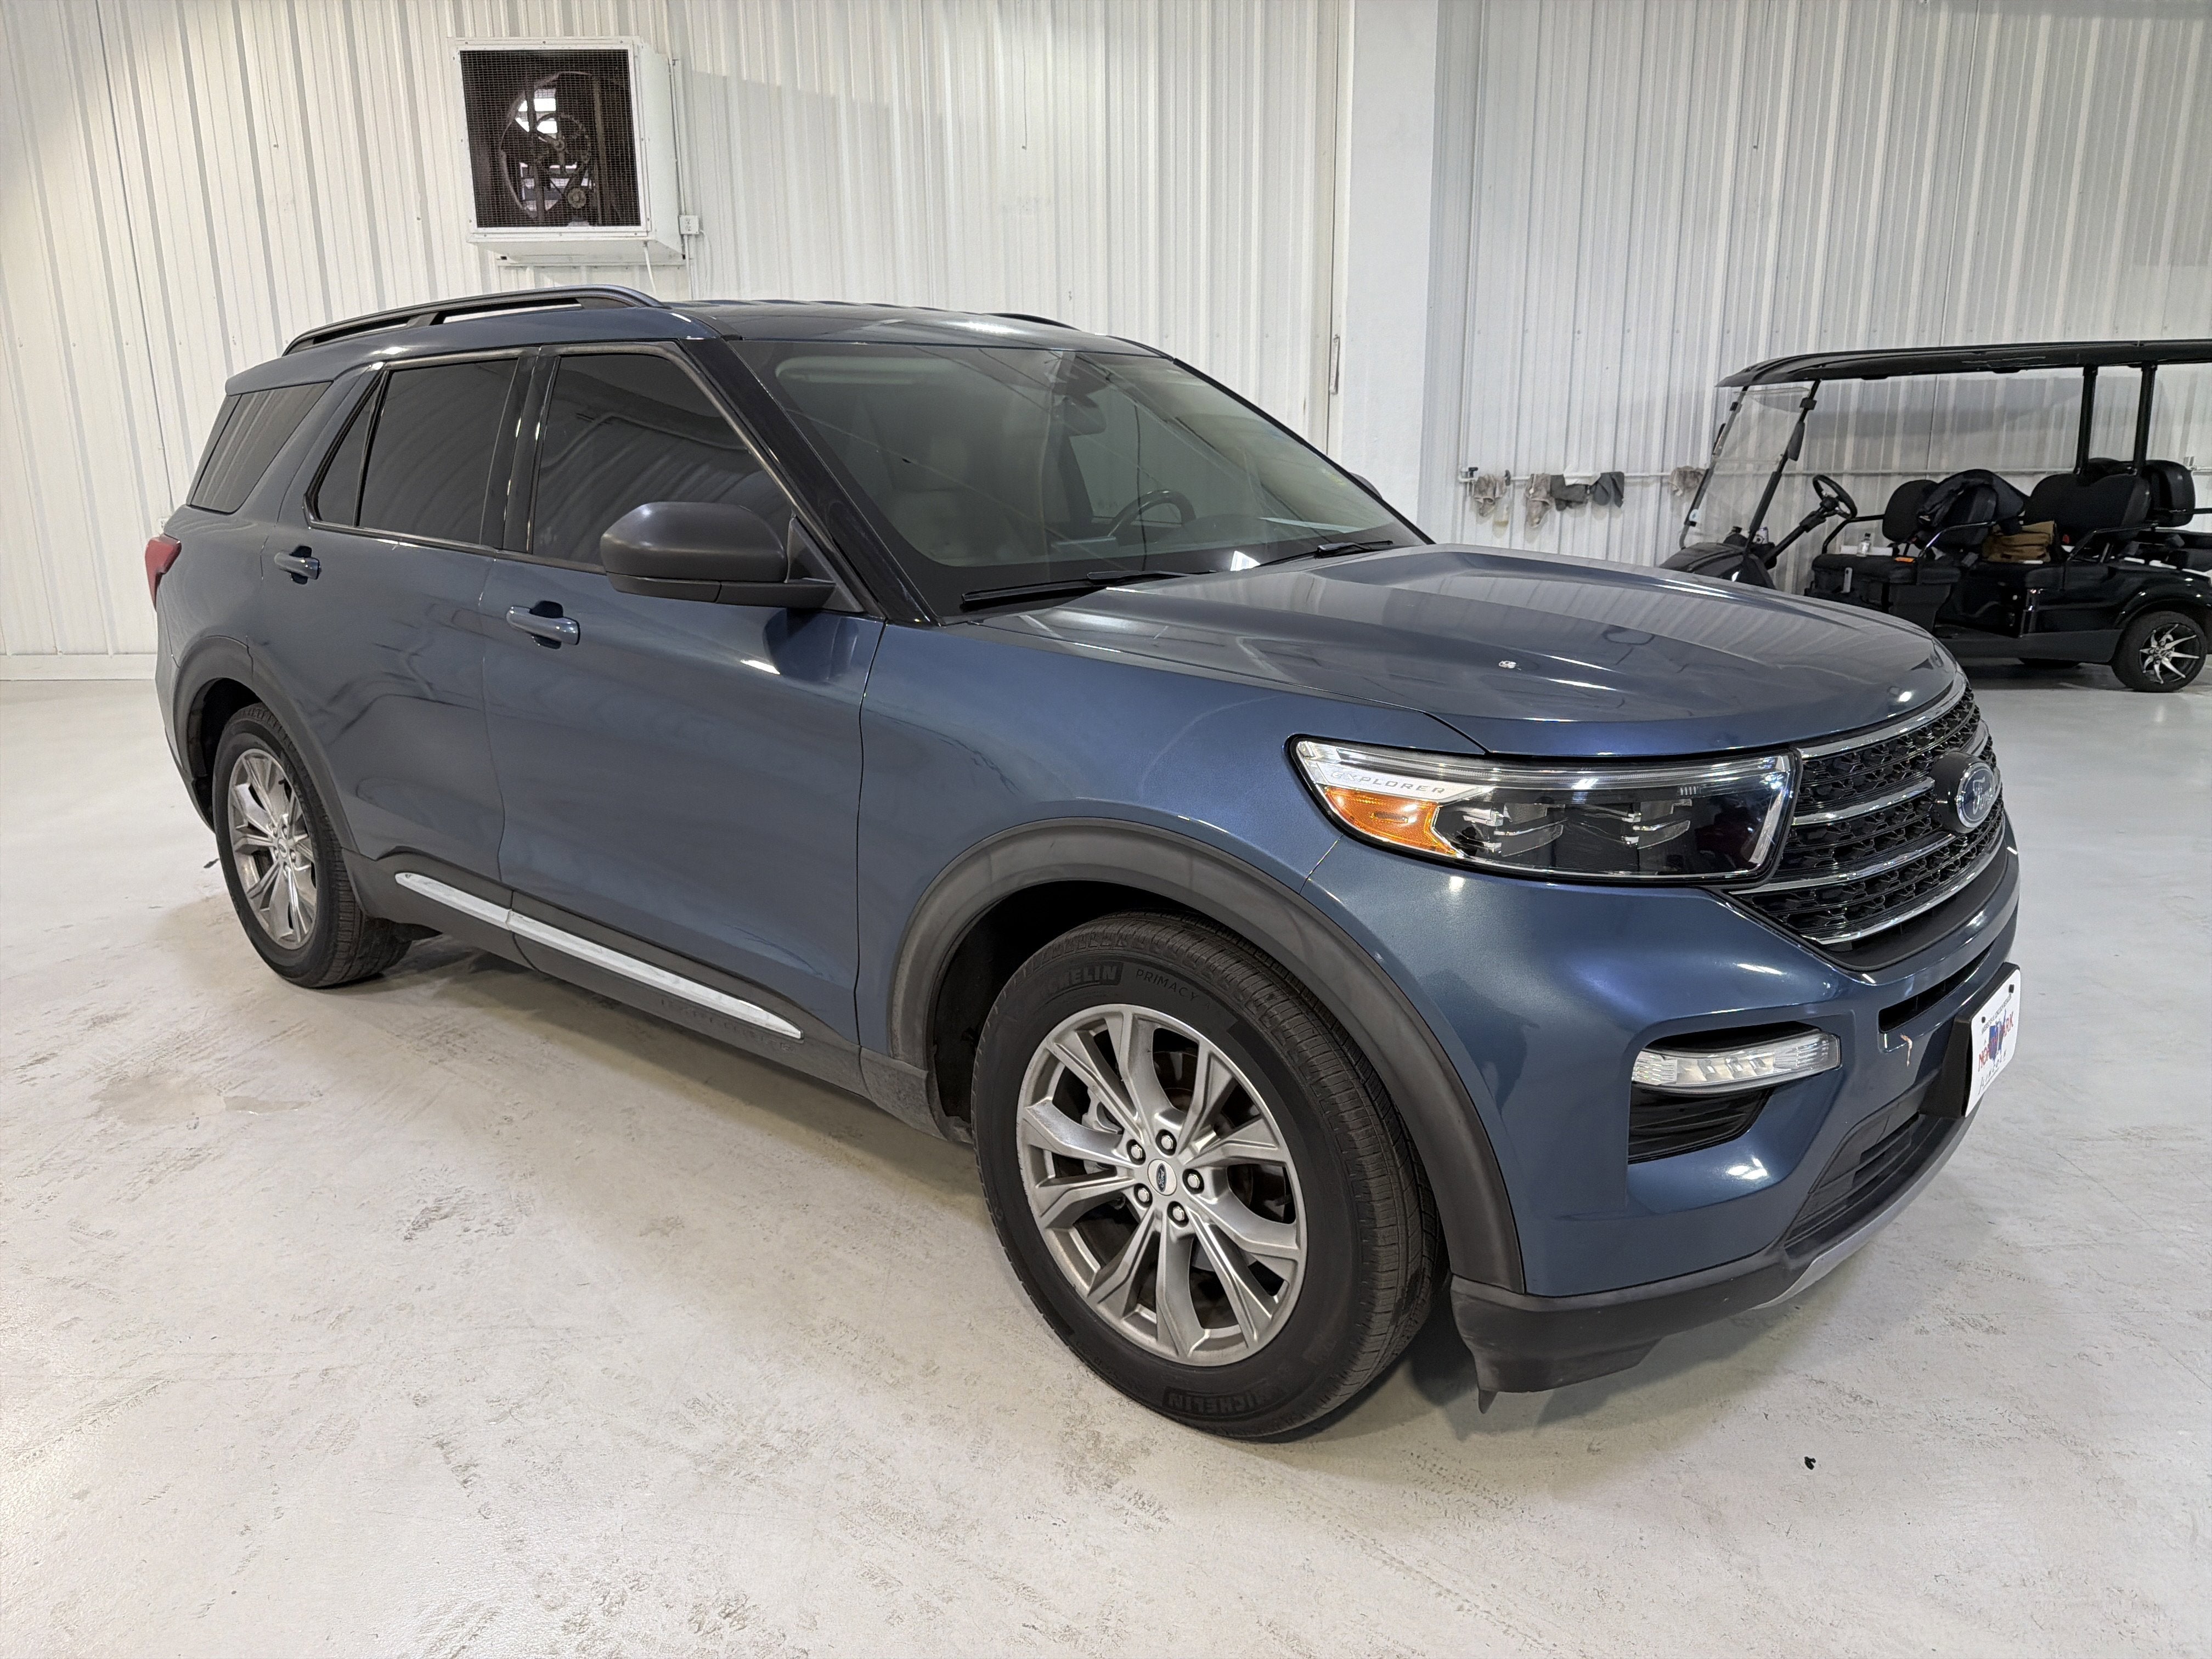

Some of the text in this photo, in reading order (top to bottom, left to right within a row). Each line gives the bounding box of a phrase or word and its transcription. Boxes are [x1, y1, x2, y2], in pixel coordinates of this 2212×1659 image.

[1330, 771, 1446, 794] EXPLORER
[1972, 775, 1993, 816] Ford
[1136, 968, 1199, 1001] PRIMACY
